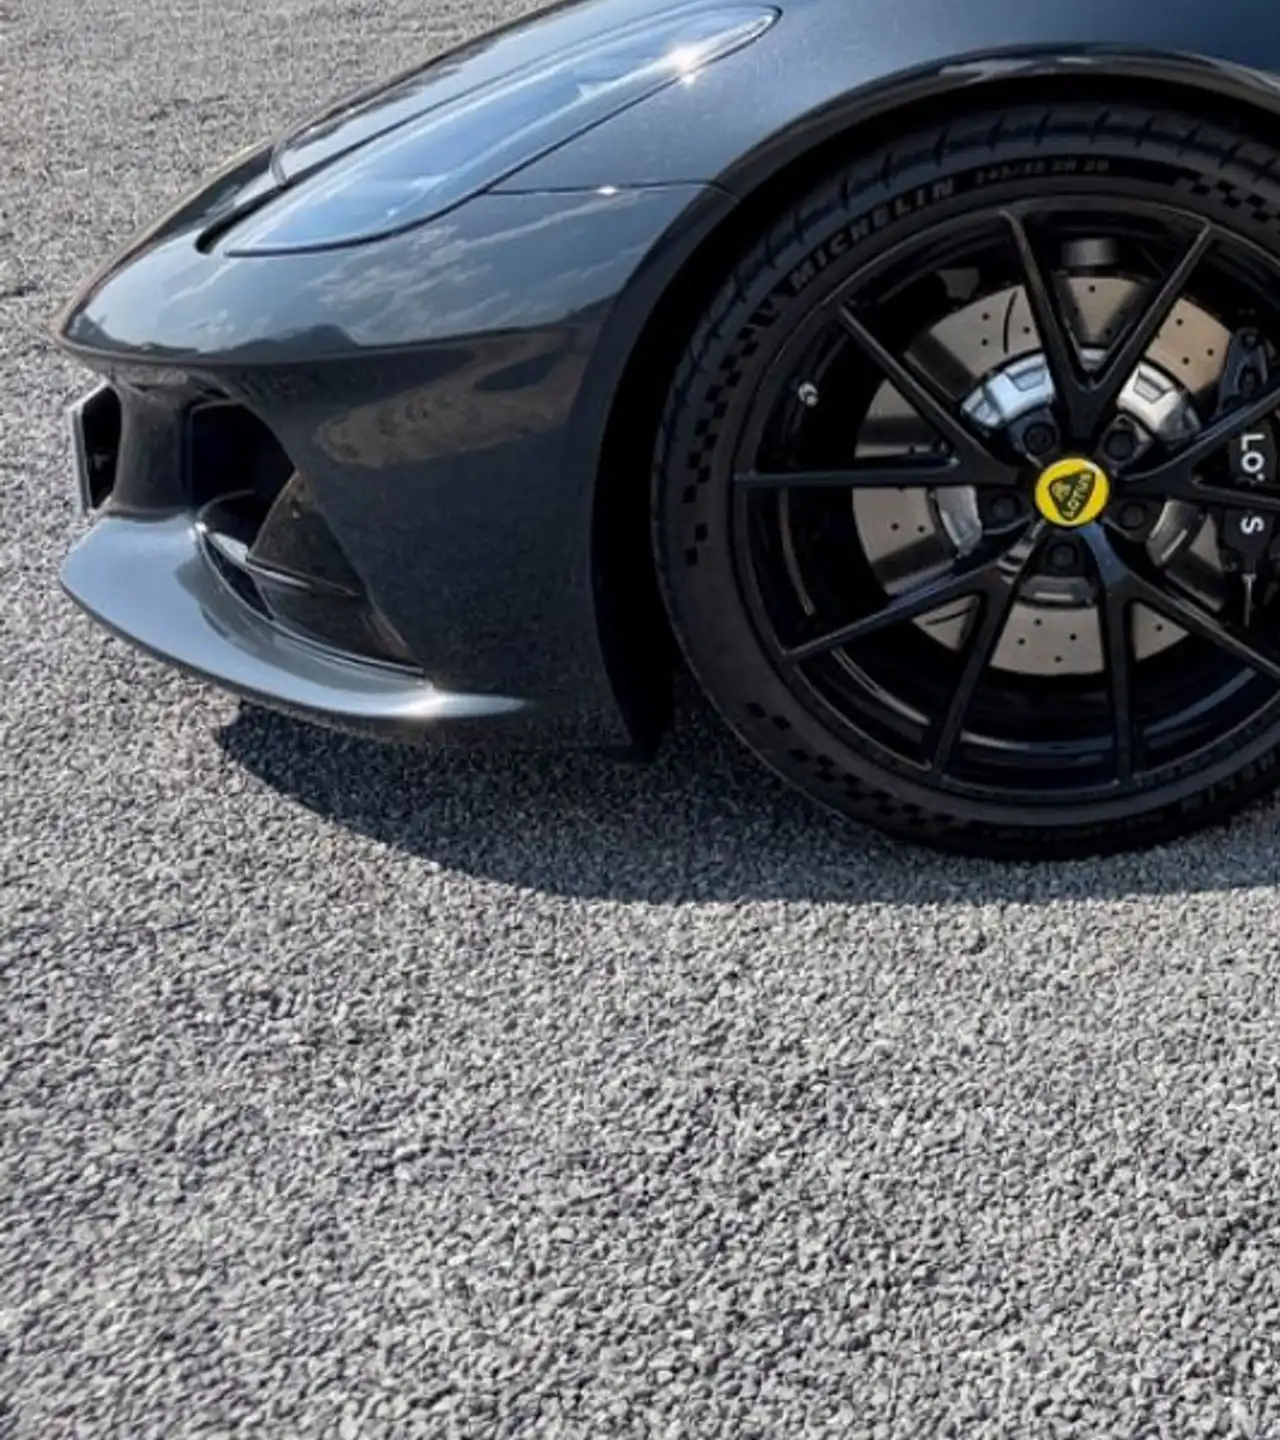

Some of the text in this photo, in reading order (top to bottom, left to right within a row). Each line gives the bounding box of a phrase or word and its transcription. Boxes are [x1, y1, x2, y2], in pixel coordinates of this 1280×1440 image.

[787, 176, 955, 291] MICHELIN
[1062, 473, 1092, 518] LOTUS
[1240, 433, 1266, 535] LOS
